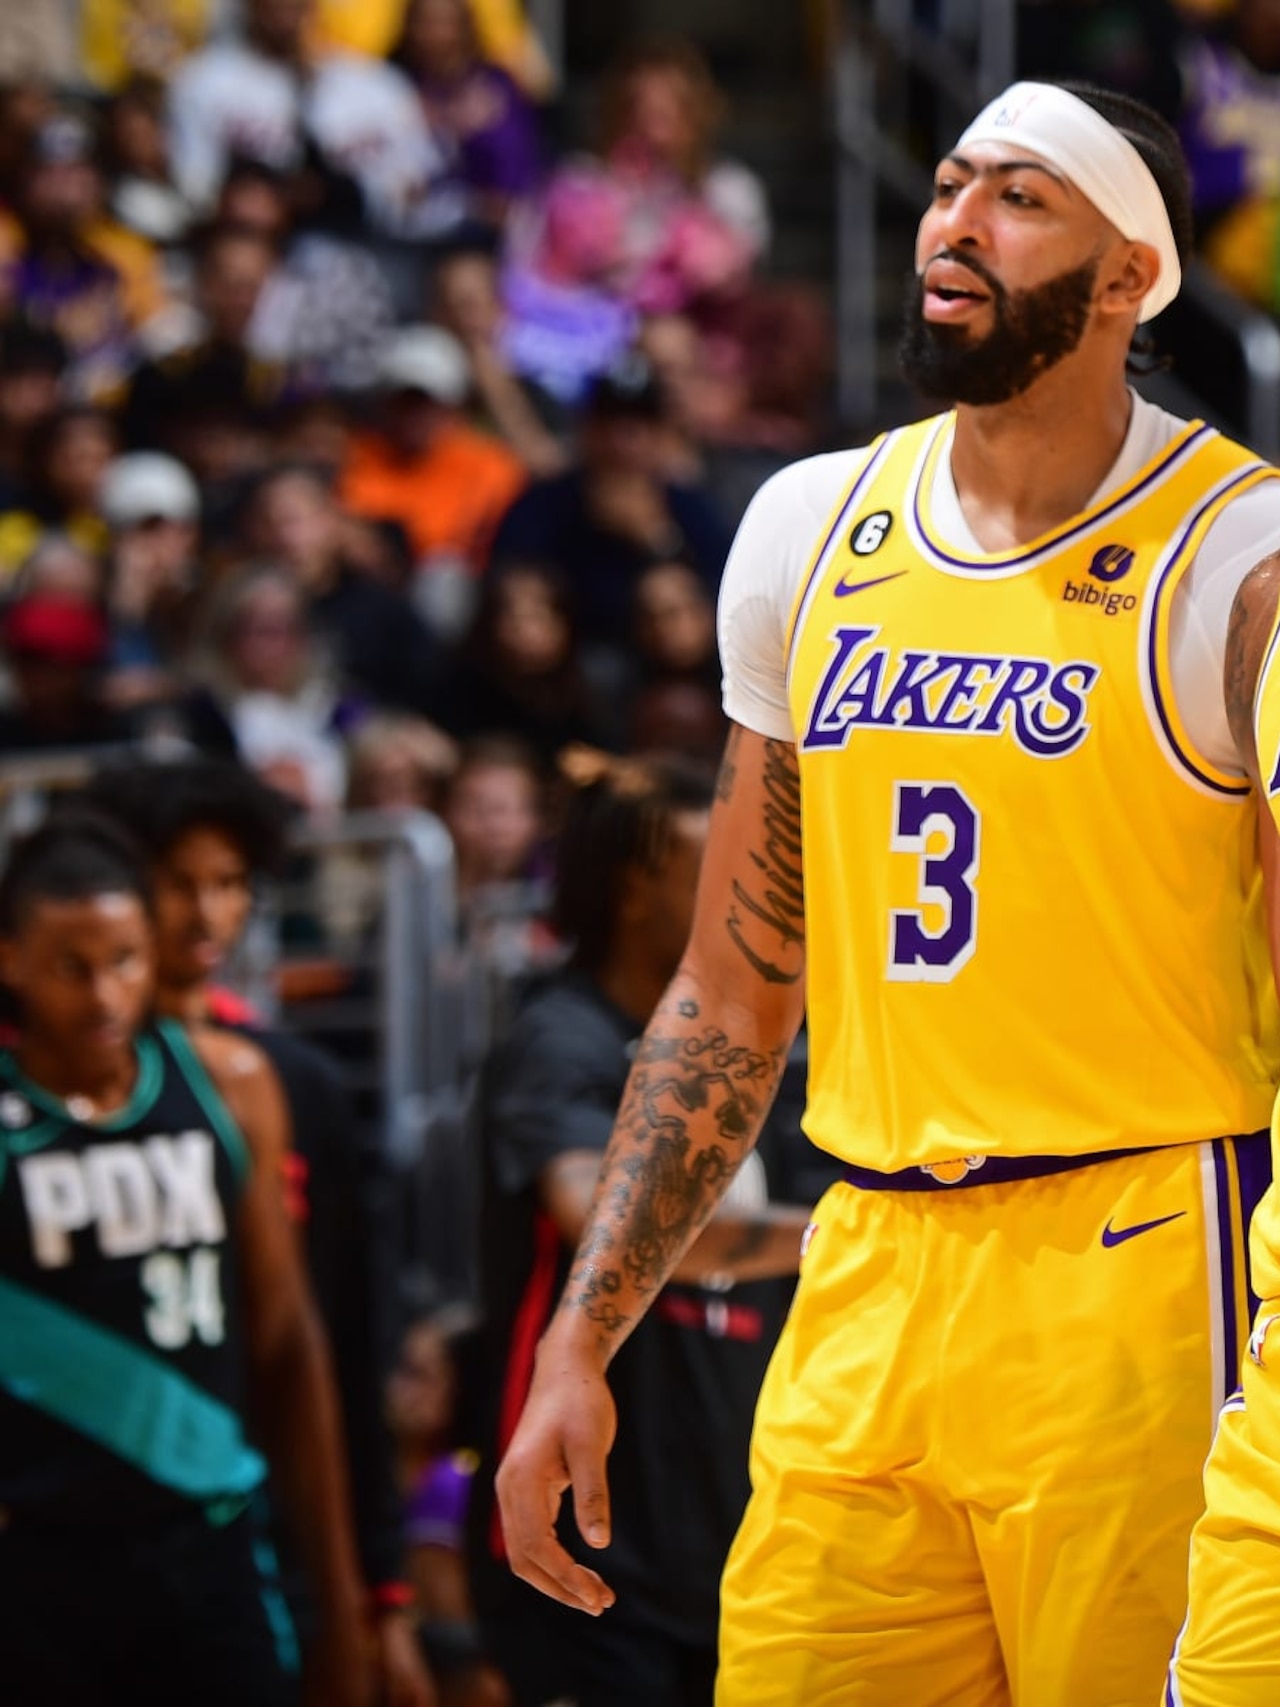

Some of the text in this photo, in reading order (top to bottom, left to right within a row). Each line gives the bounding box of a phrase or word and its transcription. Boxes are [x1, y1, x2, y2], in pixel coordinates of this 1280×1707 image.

[853, 512, 890, 554] 6
[1062, 580, 1137, 616] bibigo
[802, 626, 1100, 758] LAKERS
[887, 780, 982, 982] 3
[18, 1129, 226, 1269] PDX
[141, 1249, 225, 1349] 34
